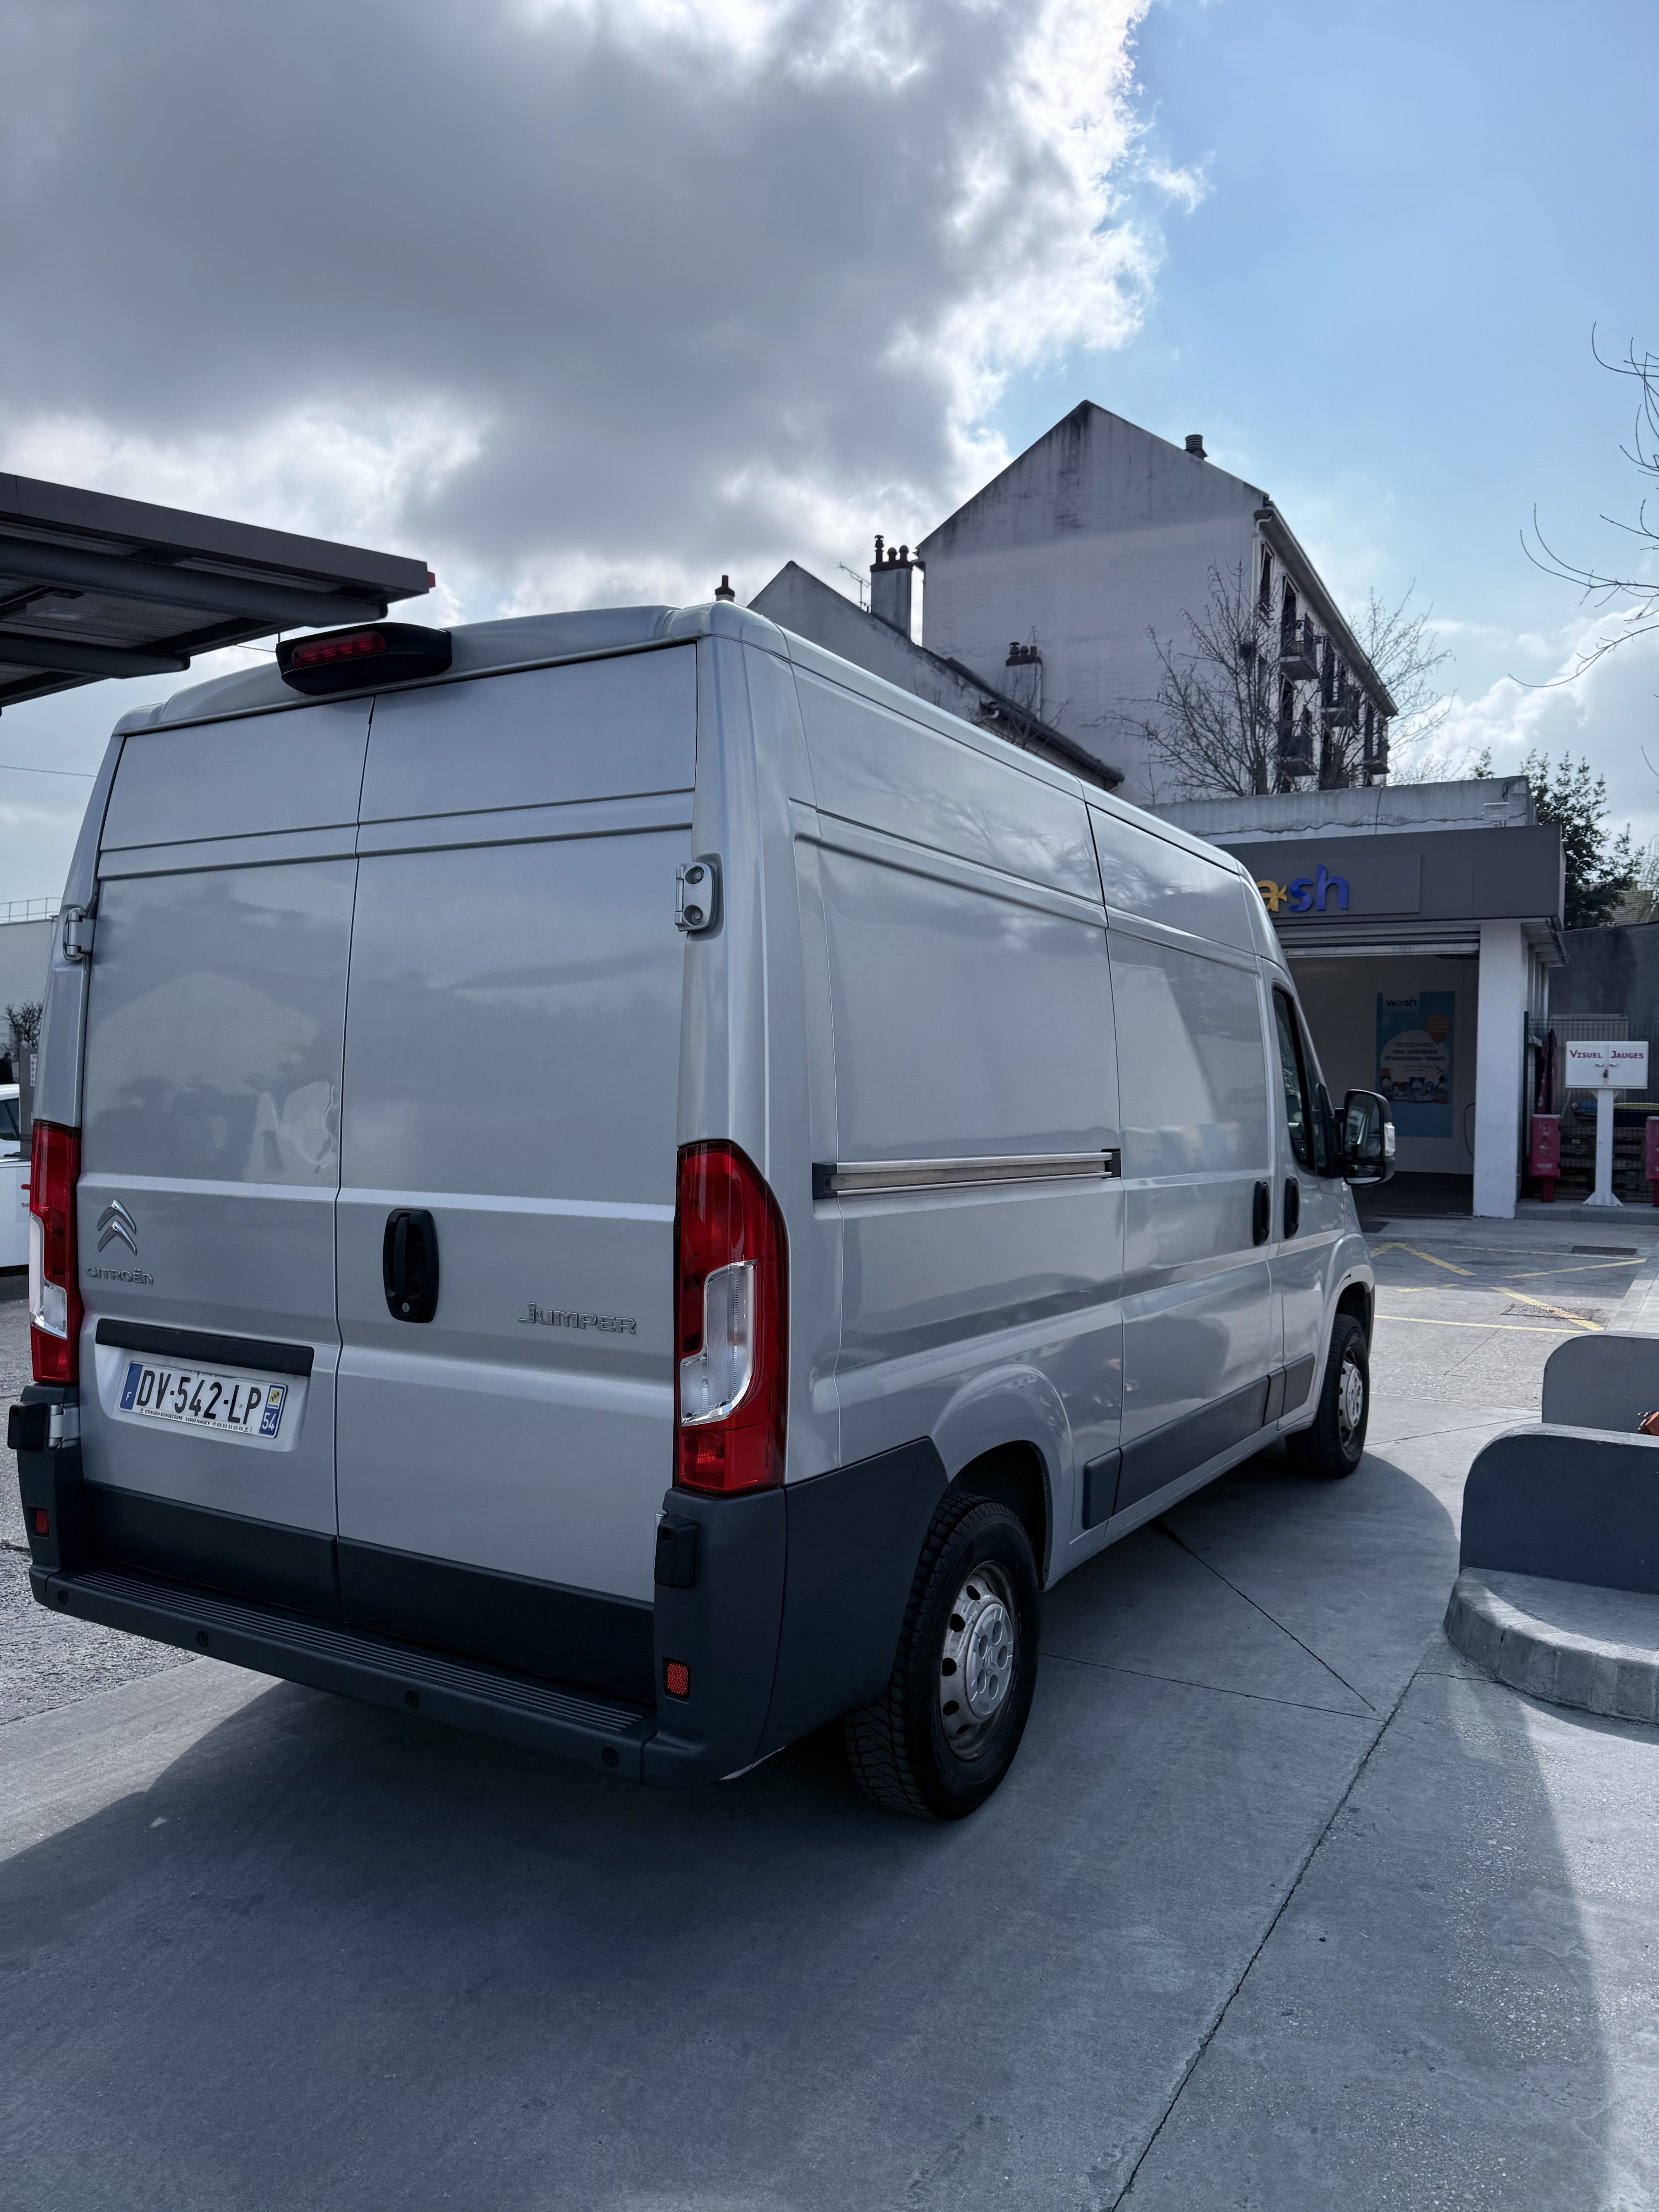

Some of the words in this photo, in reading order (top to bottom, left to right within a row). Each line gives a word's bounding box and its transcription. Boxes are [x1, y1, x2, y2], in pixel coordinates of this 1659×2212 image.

[126, 1391, 132, 1401] F
[136, 1370, 262, 1425] DV-542-LP
[262, 1412, 276, 1431] 54
